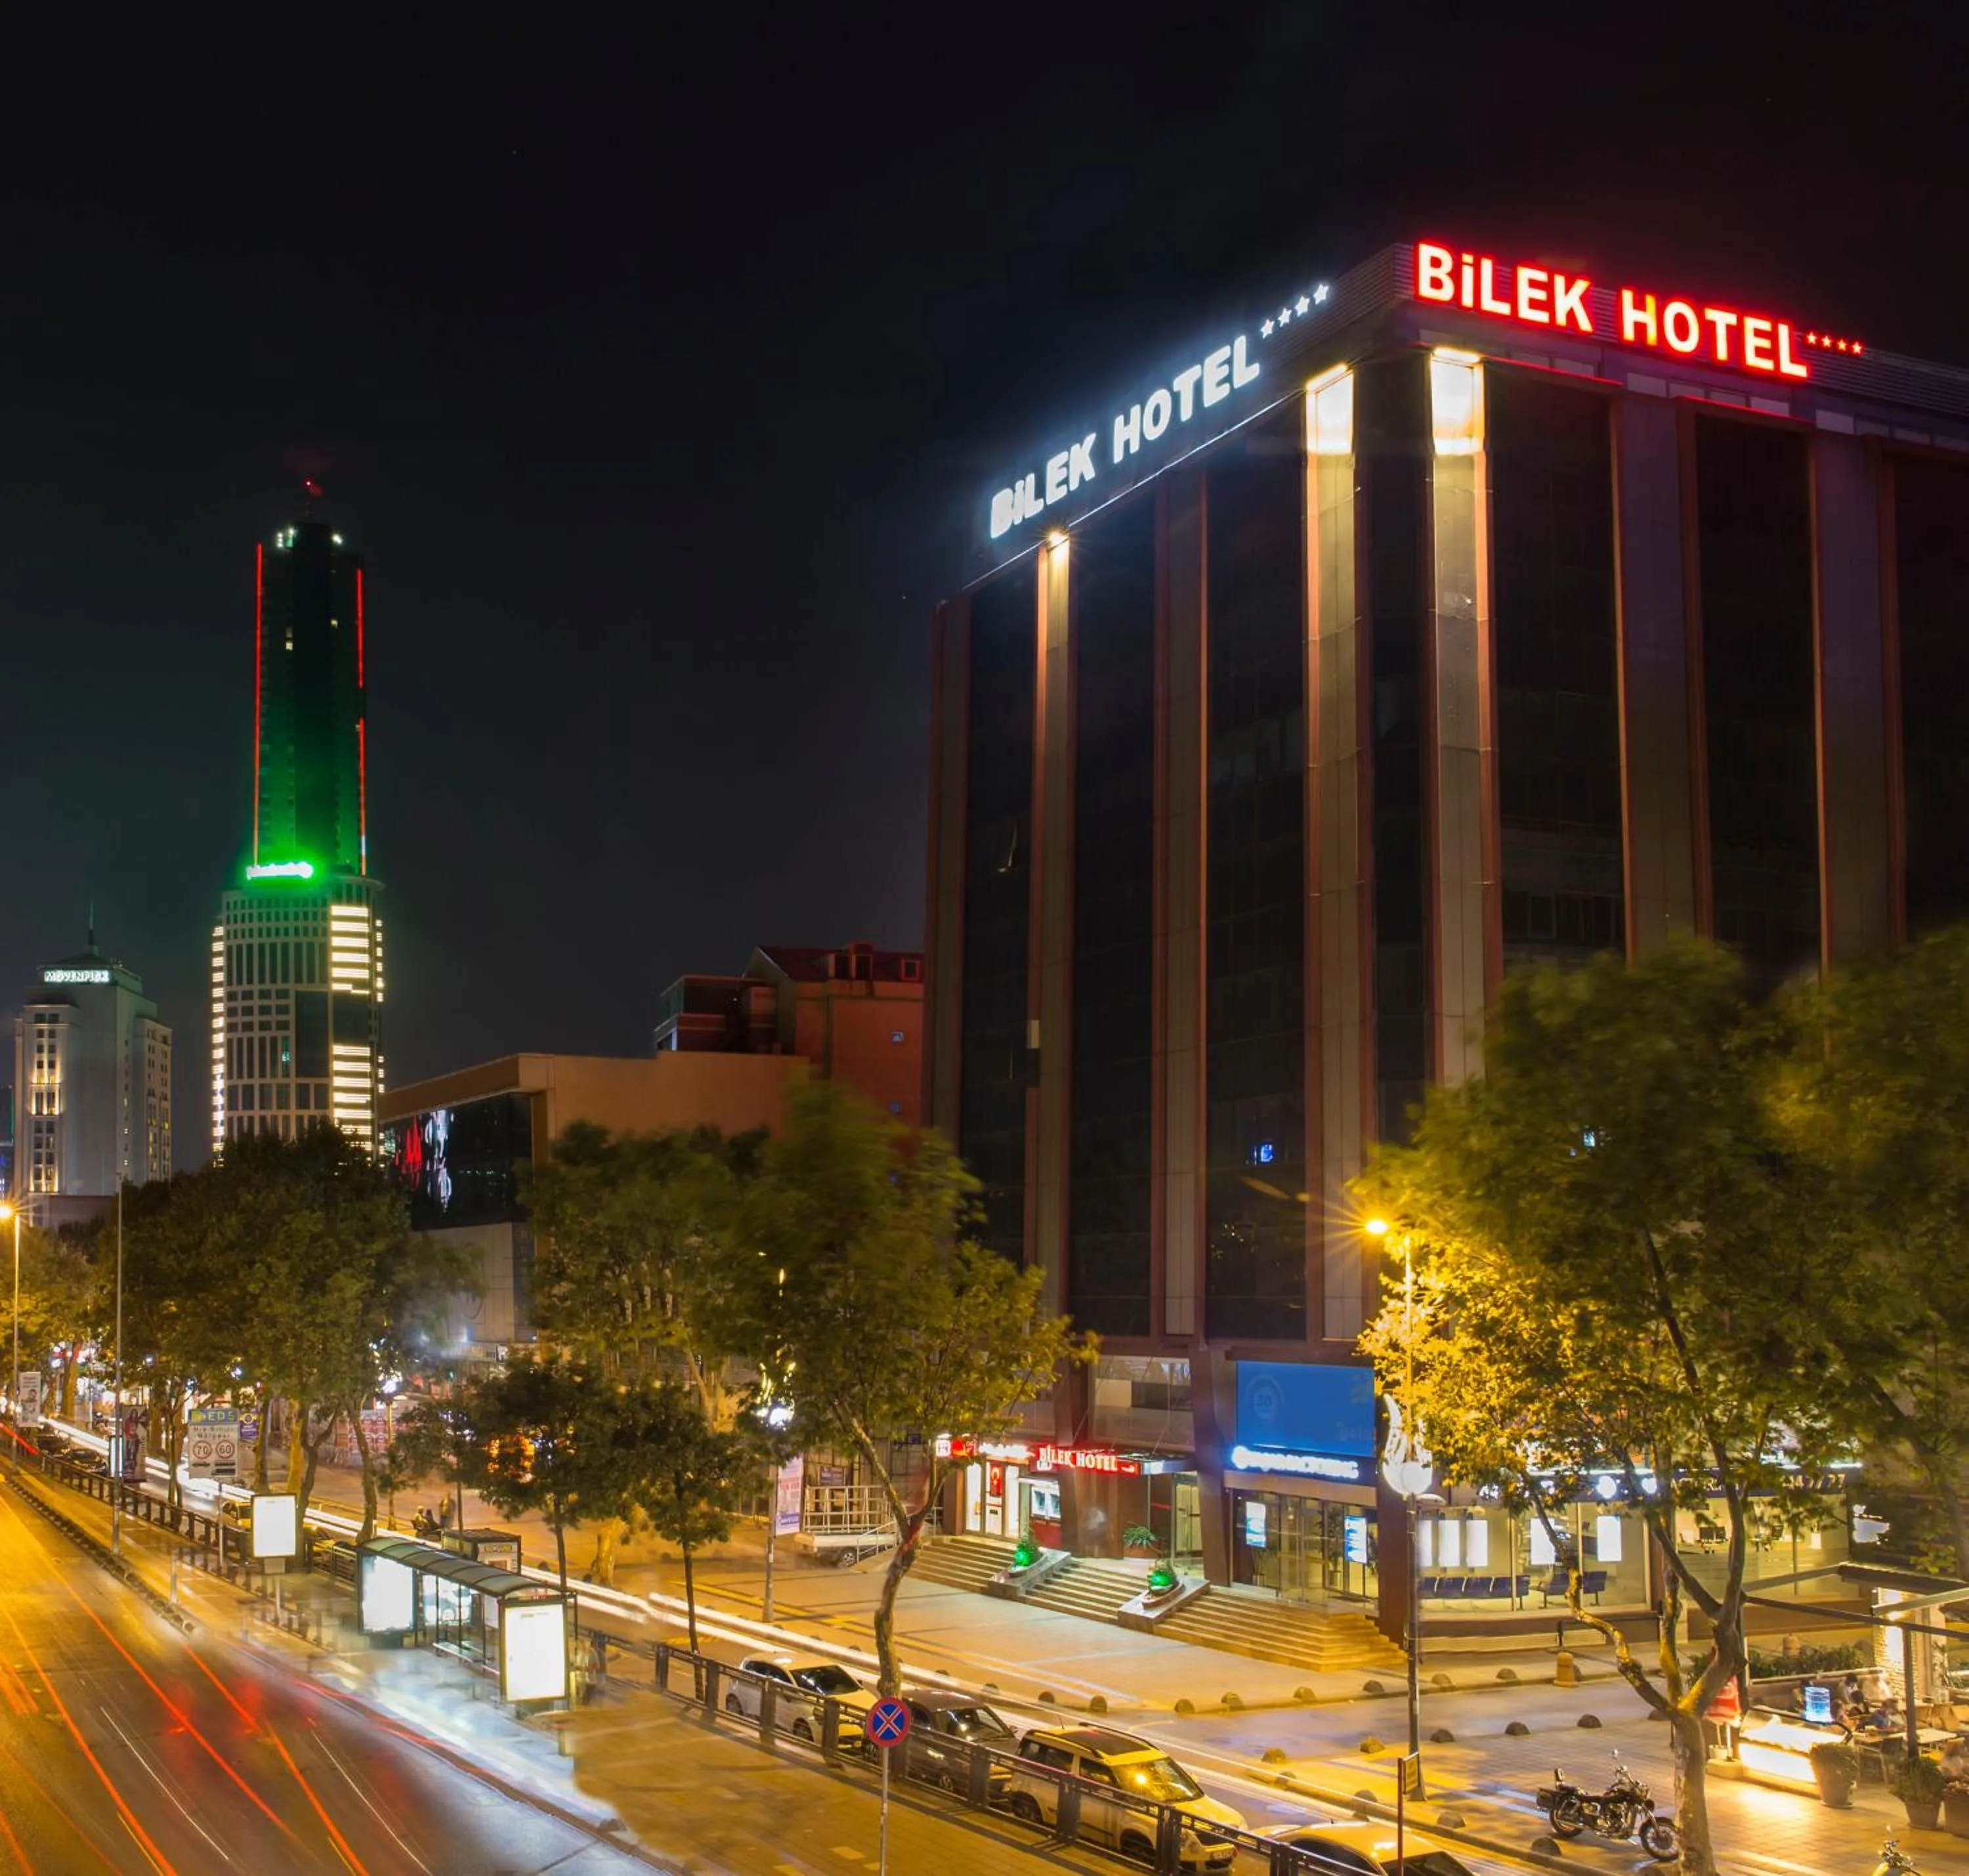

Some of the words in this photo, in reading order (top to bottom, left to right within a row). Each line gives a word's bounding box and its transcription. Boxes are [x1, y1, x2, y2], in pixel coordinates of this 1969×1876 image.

[1620, 288, 1810, 379] HOTEL
[1112, 335, 1261, 465] HOTEL
[198, 1445, 209, 1455] 70
[219, 1445, 232, 1454] 60
[1076, 1451, 1117, 1471] HOTEL
